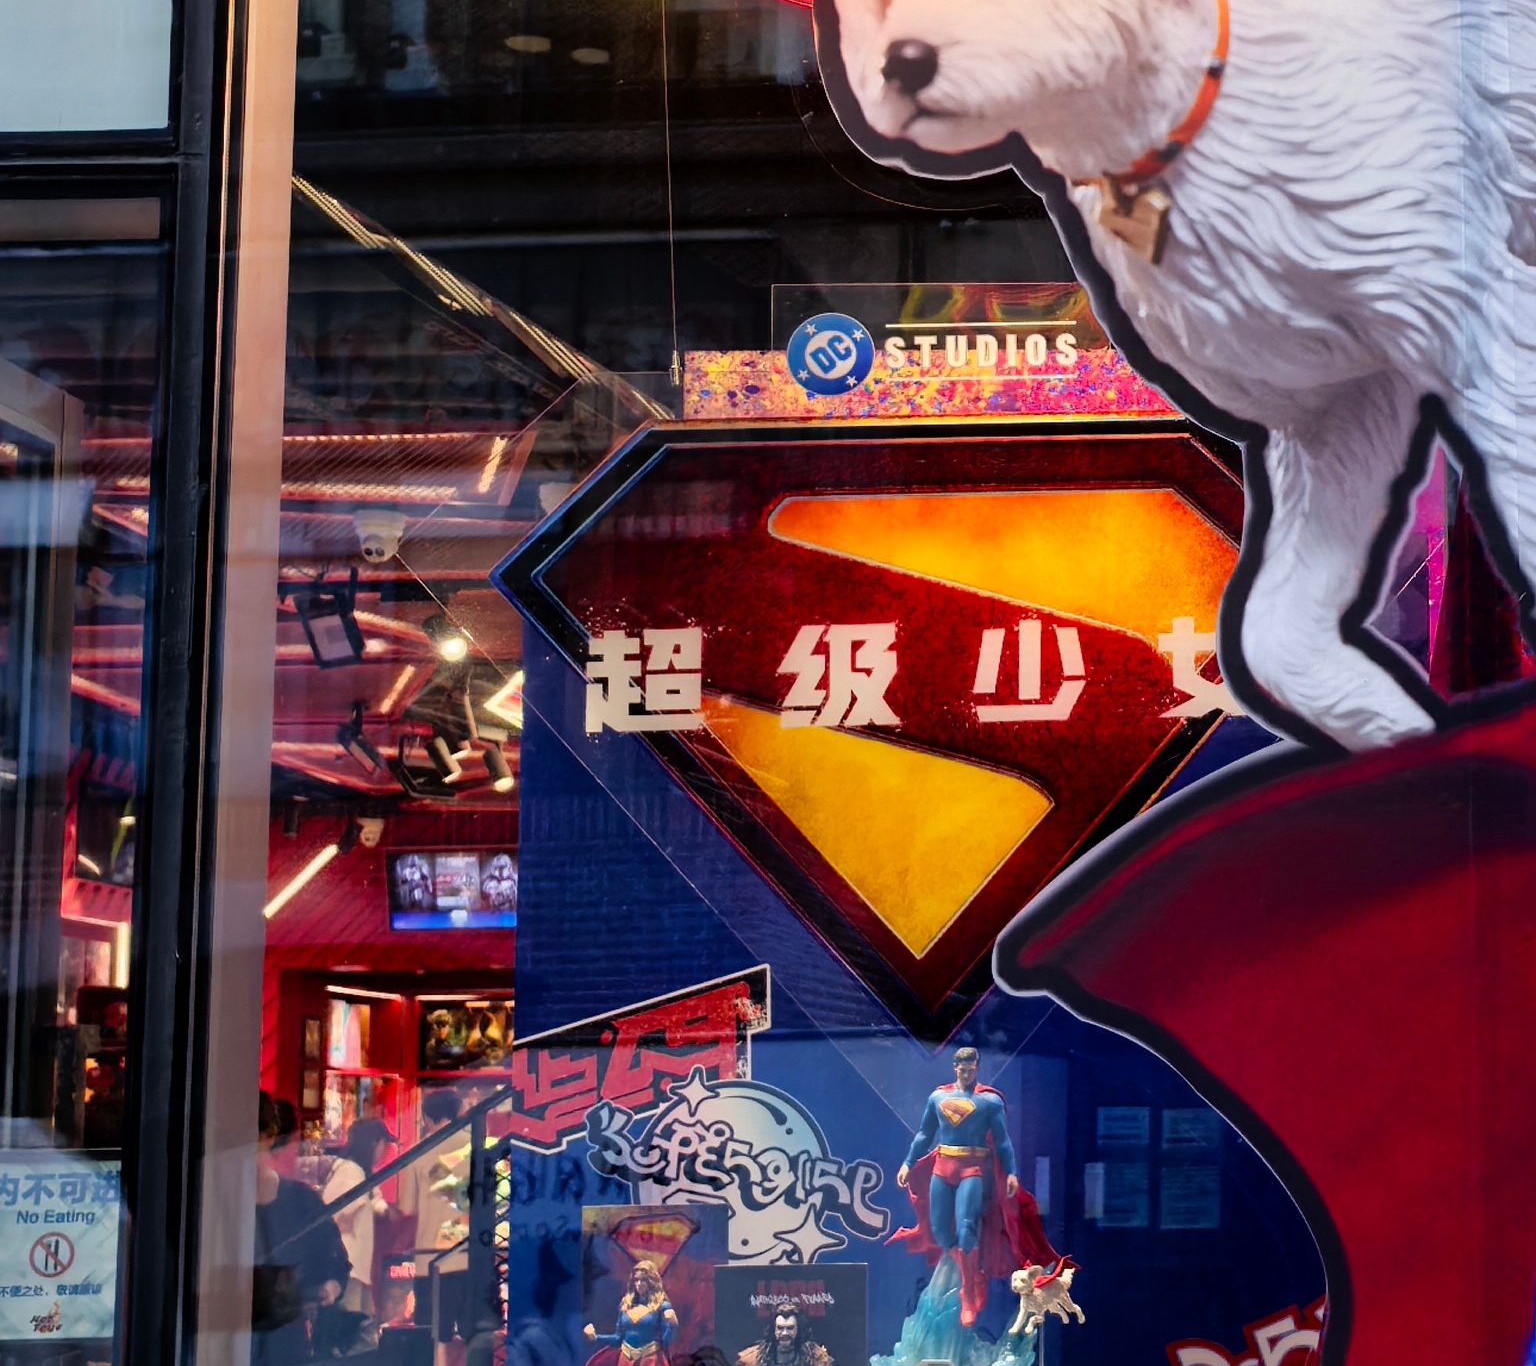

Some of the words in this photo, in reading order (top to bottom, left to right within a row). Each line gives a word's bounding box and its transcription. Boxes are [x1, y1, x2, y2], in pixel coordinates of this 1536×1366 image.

[808, 334, 854, 374] DC
[885, 332, 1078, 369] STUDIOS
[16, 1210, 39, 1224] No
[44, 1209, 95, 1225] Eating
